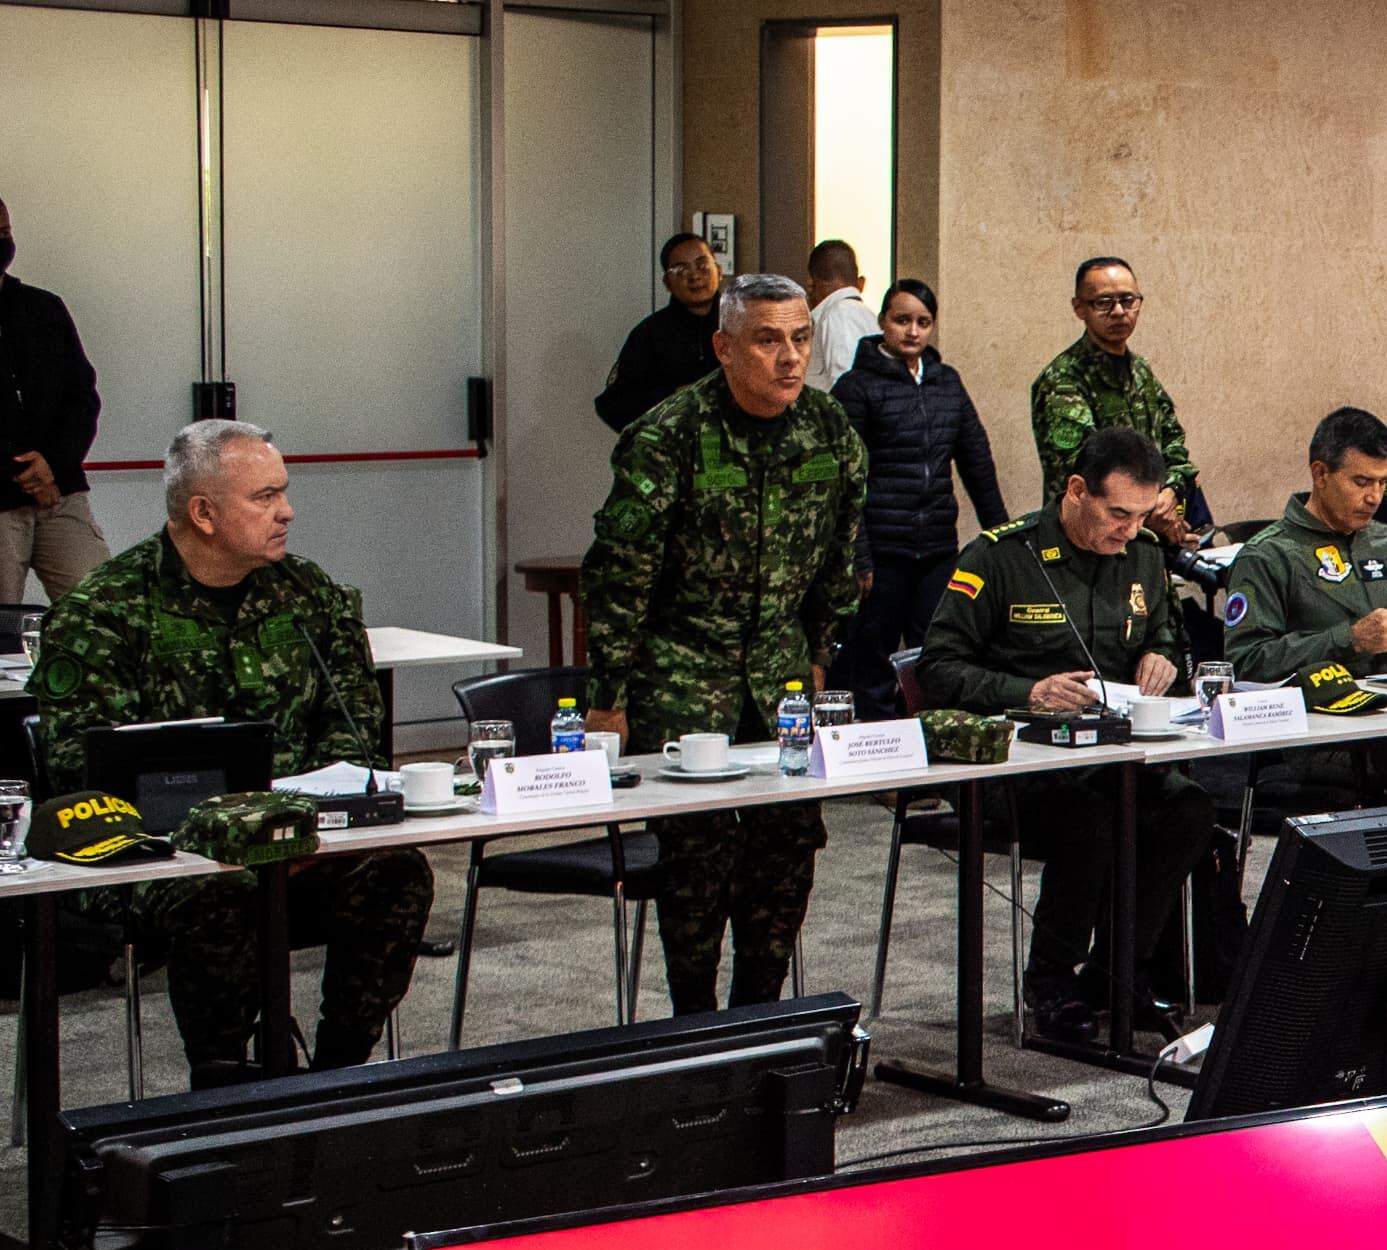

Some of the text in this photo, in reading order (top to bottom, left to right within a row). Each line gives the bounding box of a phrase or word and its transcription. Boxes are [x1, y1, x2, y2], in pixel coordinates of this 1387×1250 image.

[534, 771, 572, 781] RODOLFO
[517, 780, 586, 792] MORALES FRANCO
